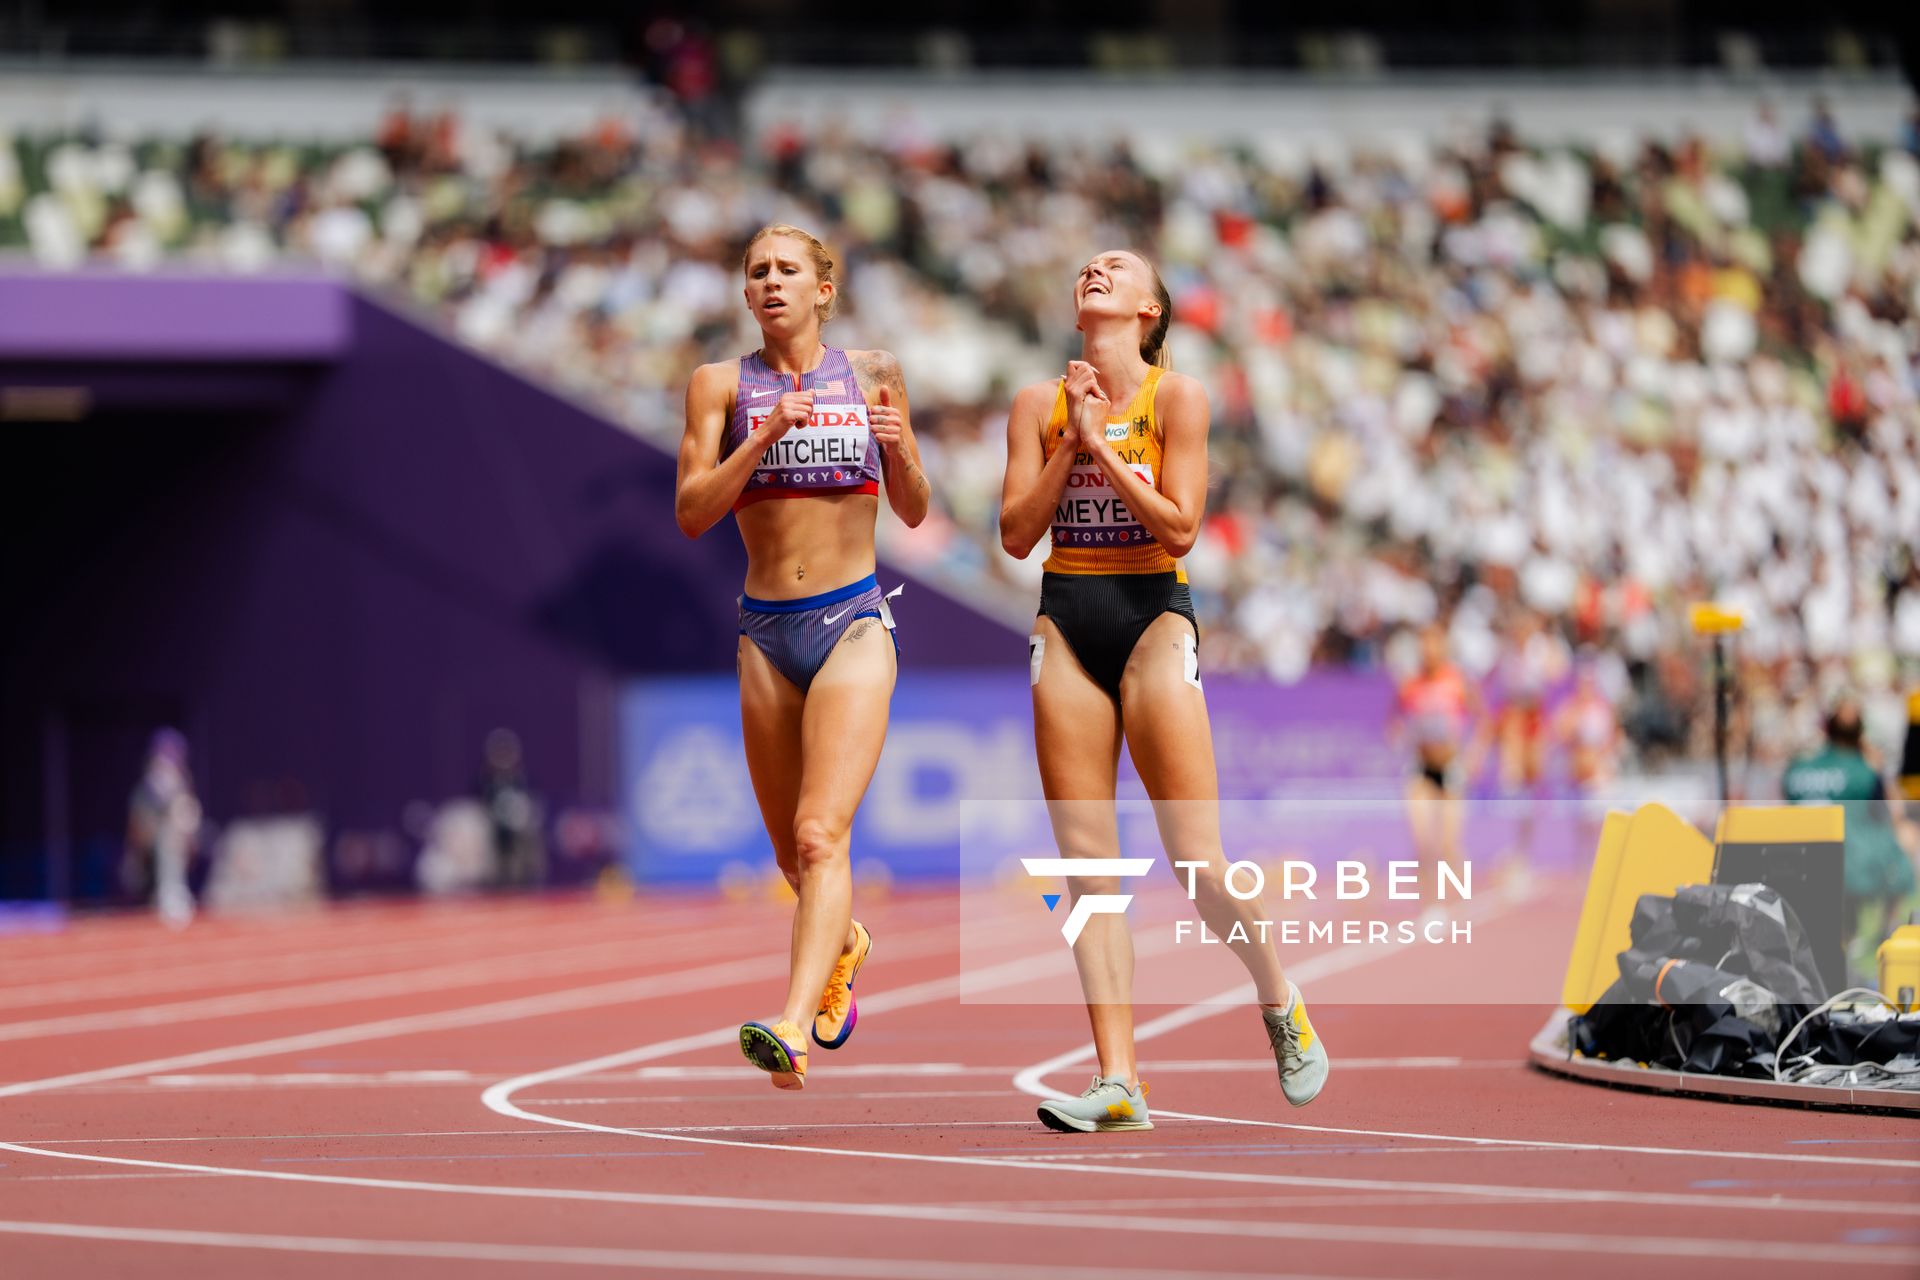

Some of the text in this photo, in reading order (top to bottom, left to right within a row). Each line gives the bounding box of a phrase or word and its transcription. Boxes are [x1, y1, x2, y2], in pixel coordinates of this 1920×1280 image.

[750, 411, 866, 431] HNDA
[758, 438, 861, 467] MITCHELL
[1056, 499, 1137, 524] MEYE
